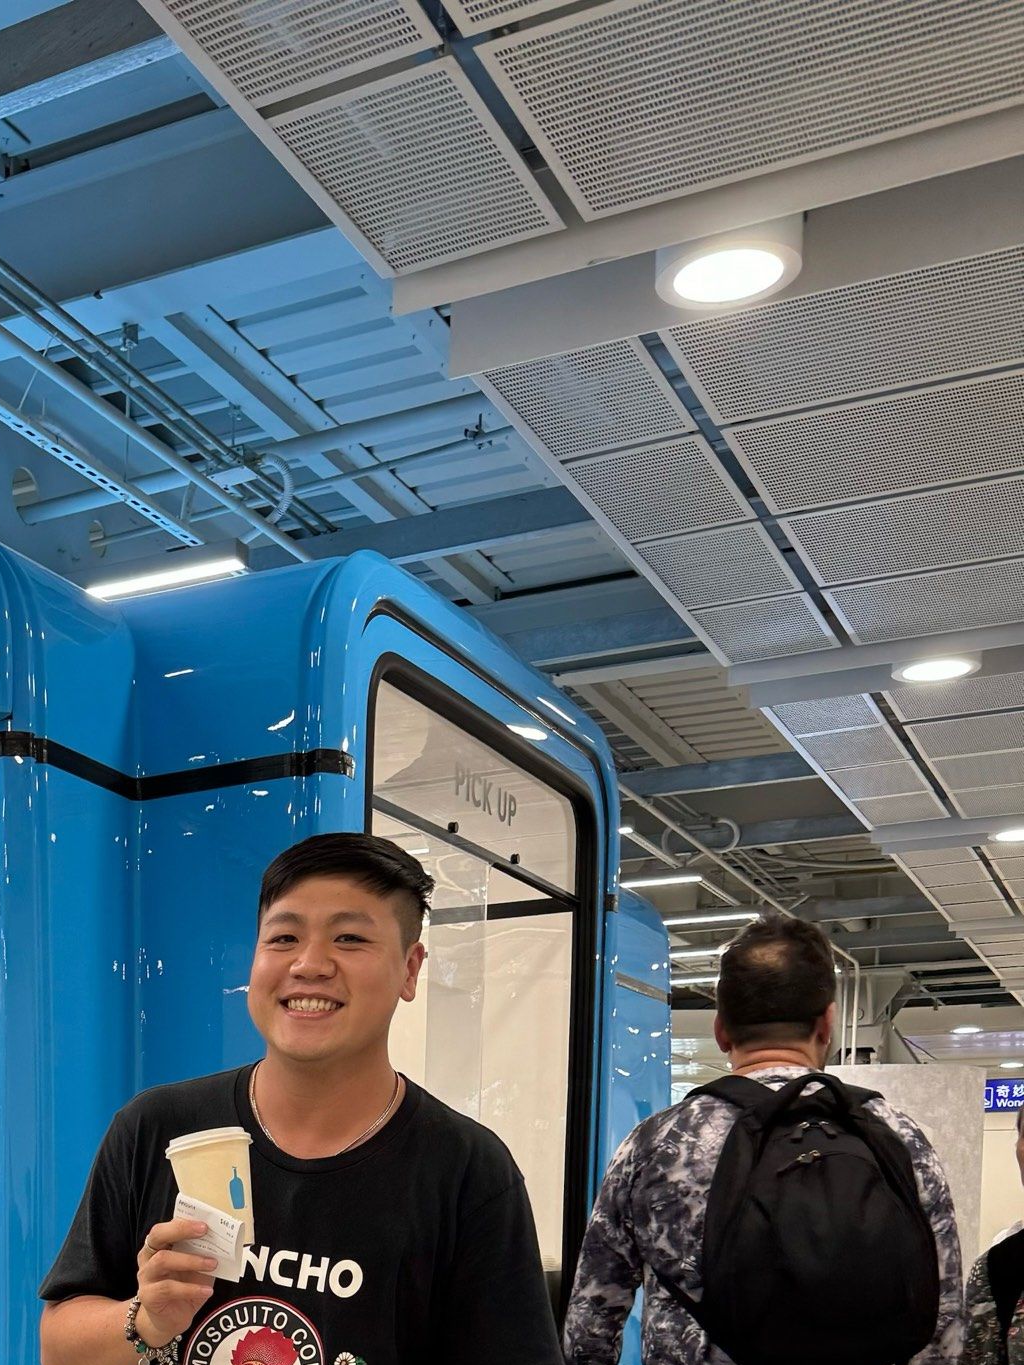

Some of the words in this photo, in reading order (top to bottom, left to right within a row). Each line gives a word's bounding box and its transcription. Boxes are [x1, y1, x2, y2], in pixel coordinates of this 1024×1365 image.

[454, 762, 493, 816] PICK
[498, 787, 517, 827] UP
[241, 1245, 364, 1299] NCHO
